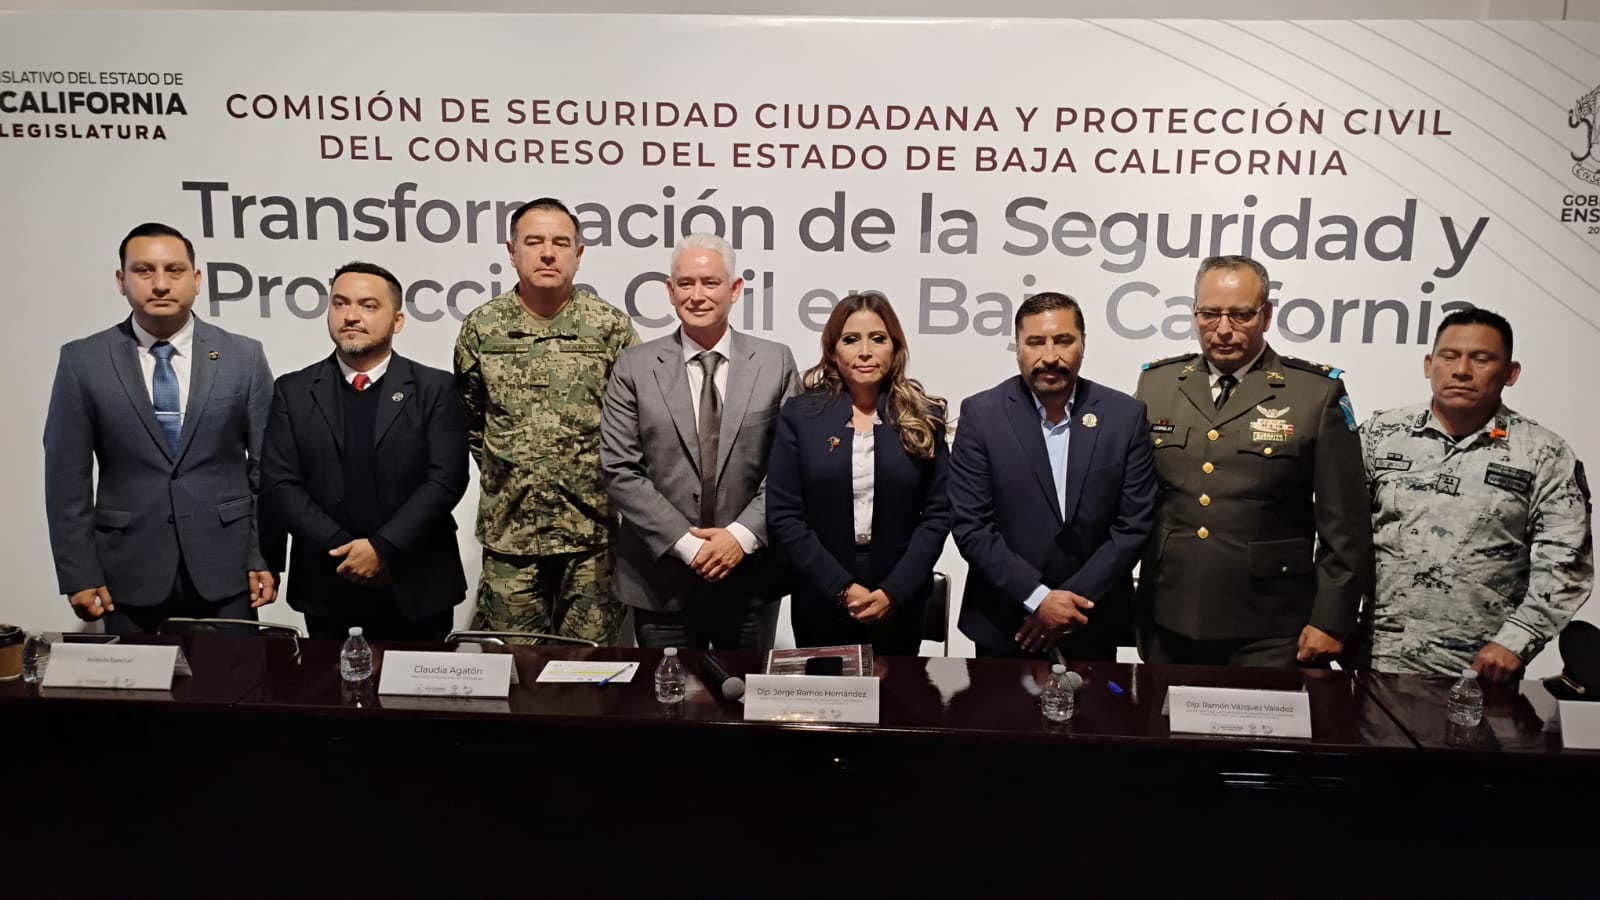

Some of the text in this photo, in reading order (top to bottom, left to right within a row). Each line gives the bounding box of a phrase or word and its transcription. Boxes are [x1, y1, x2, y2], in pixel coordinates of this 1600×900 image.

[68, 72, 96, 84] DEL
[100, 72, 160, 86] ESTADO
[164, 73, 183, 86] DE
[0, 91, 187, 115] CALIFORNIA
[227, 90, 1452, 135] COMISIÓN DE SEGURIDAD CIUDADANA Y PROTECCIÓN CIVIL
[0, 123, 166, 140] LEGISLATURA
[320, 135, 1347, 175] DEL CONGRESO DEL ESTADO DE BAJA CALIFORNIA
[1563, 194, 1600, 207] GOB
[1561, 208, 1600, 223] ENS
[799, 191, 895, 253] de
[920, 193, 978, 254] la
[1003, 195, 1418, 274] Seguridad
[1433, 216, 1490, 277] y
[624, 270, 774, 331] Cil
[798, 288, 888, 333] e
[414, 665, 483, 676] Claudia Agatón
[773, 689, 795, 697] Jorge
[796, 689, 823, 697] Ramos
[824, 690, 867, 698] Hernández
